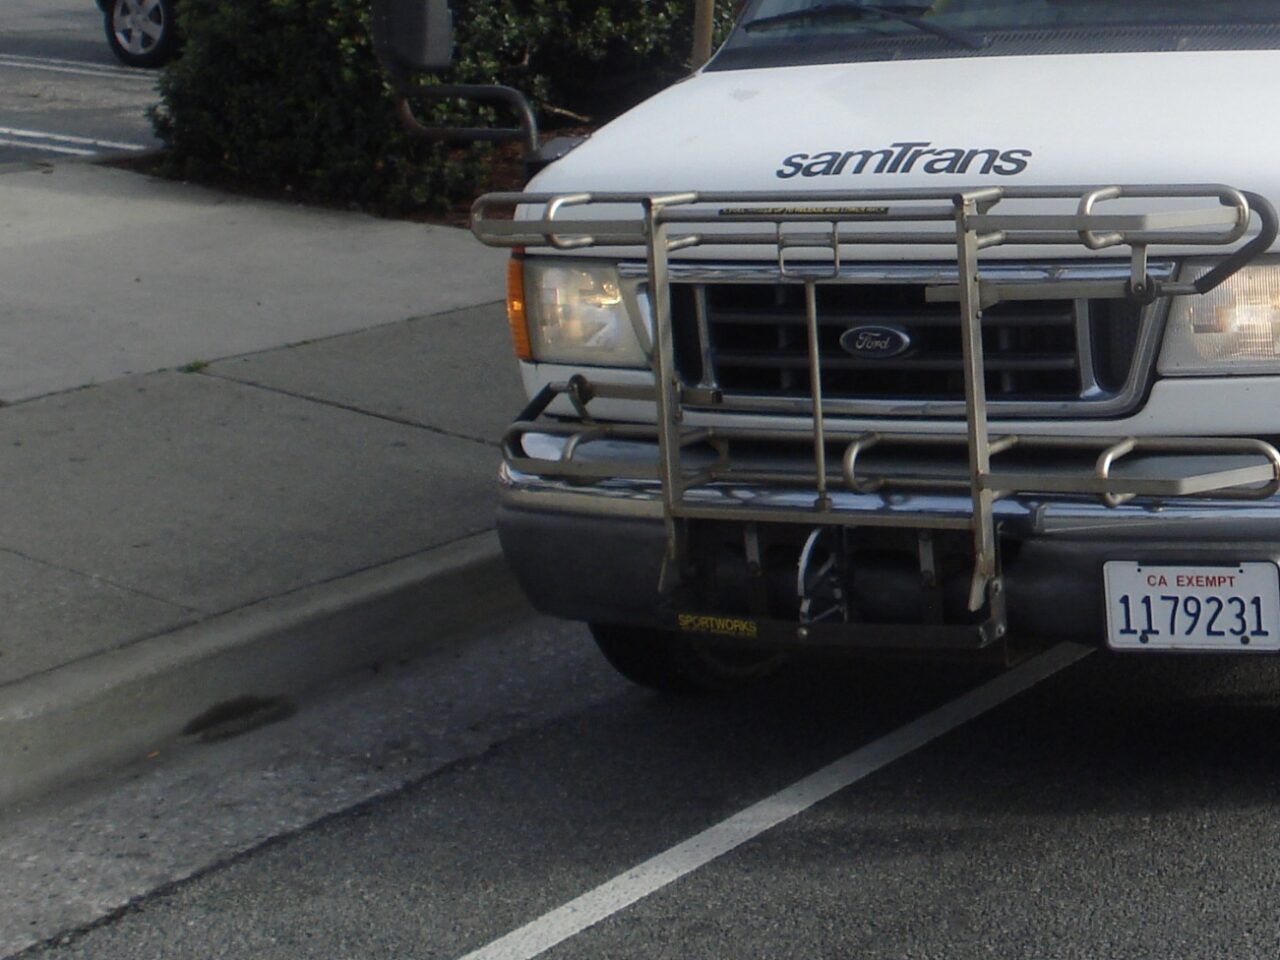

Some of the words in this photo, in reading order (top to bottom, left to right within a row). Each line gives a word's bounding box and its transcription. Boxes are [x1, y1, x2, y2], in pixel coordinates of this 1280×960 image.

[775, 141, 1033, 179] samTrans
[855, 331, 891, 350] Ford
[1147, 575, 1168, 587] CA
[1176, 575, 1236, 588] EXEMPT
[678, 614, 758, 633] SPORTWORKS
[1118, 594, 1269, 637] 1179231
